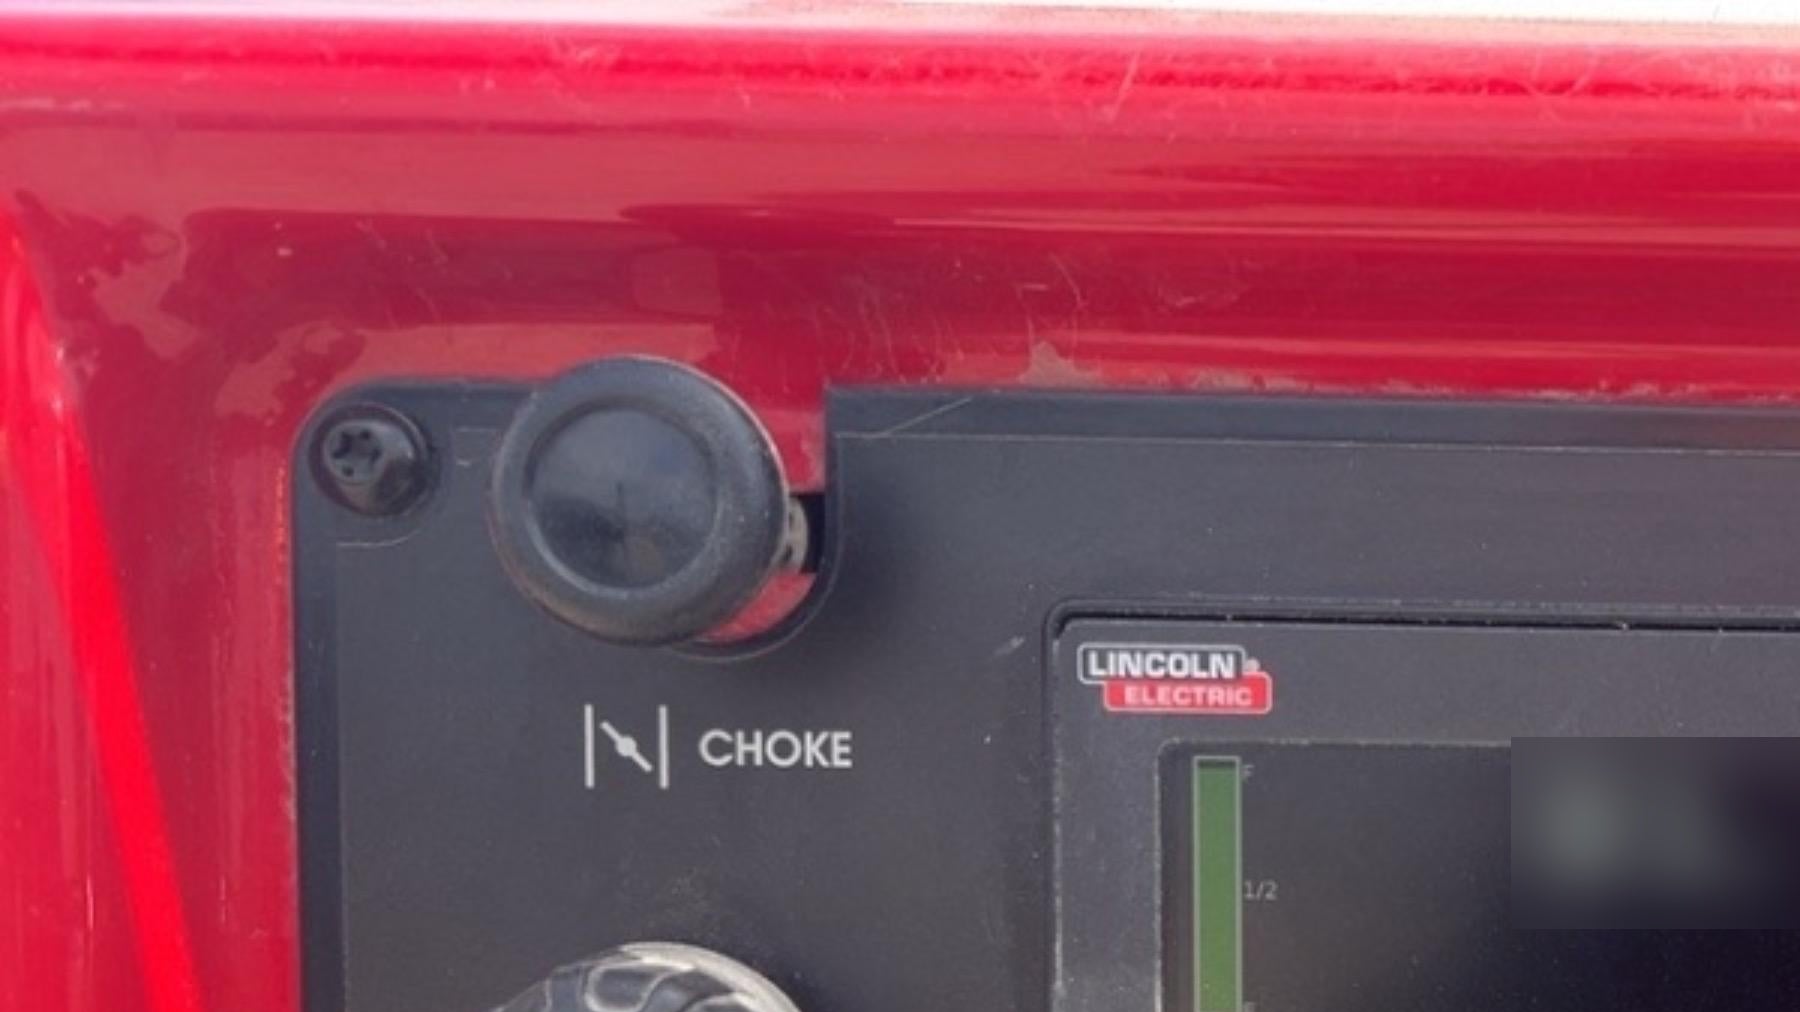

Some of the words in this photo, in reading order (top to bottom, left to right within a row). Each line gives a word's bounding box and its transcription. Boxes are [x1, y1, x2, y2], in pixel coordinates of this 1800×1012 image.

[1088, 650, 1236, 680] LINCOLN
[1123, 685, 1253, 707] ELECTRIC
[698, 728, 853, 768] CHOKE
[1243, 879, 1279, 900] 1/2
